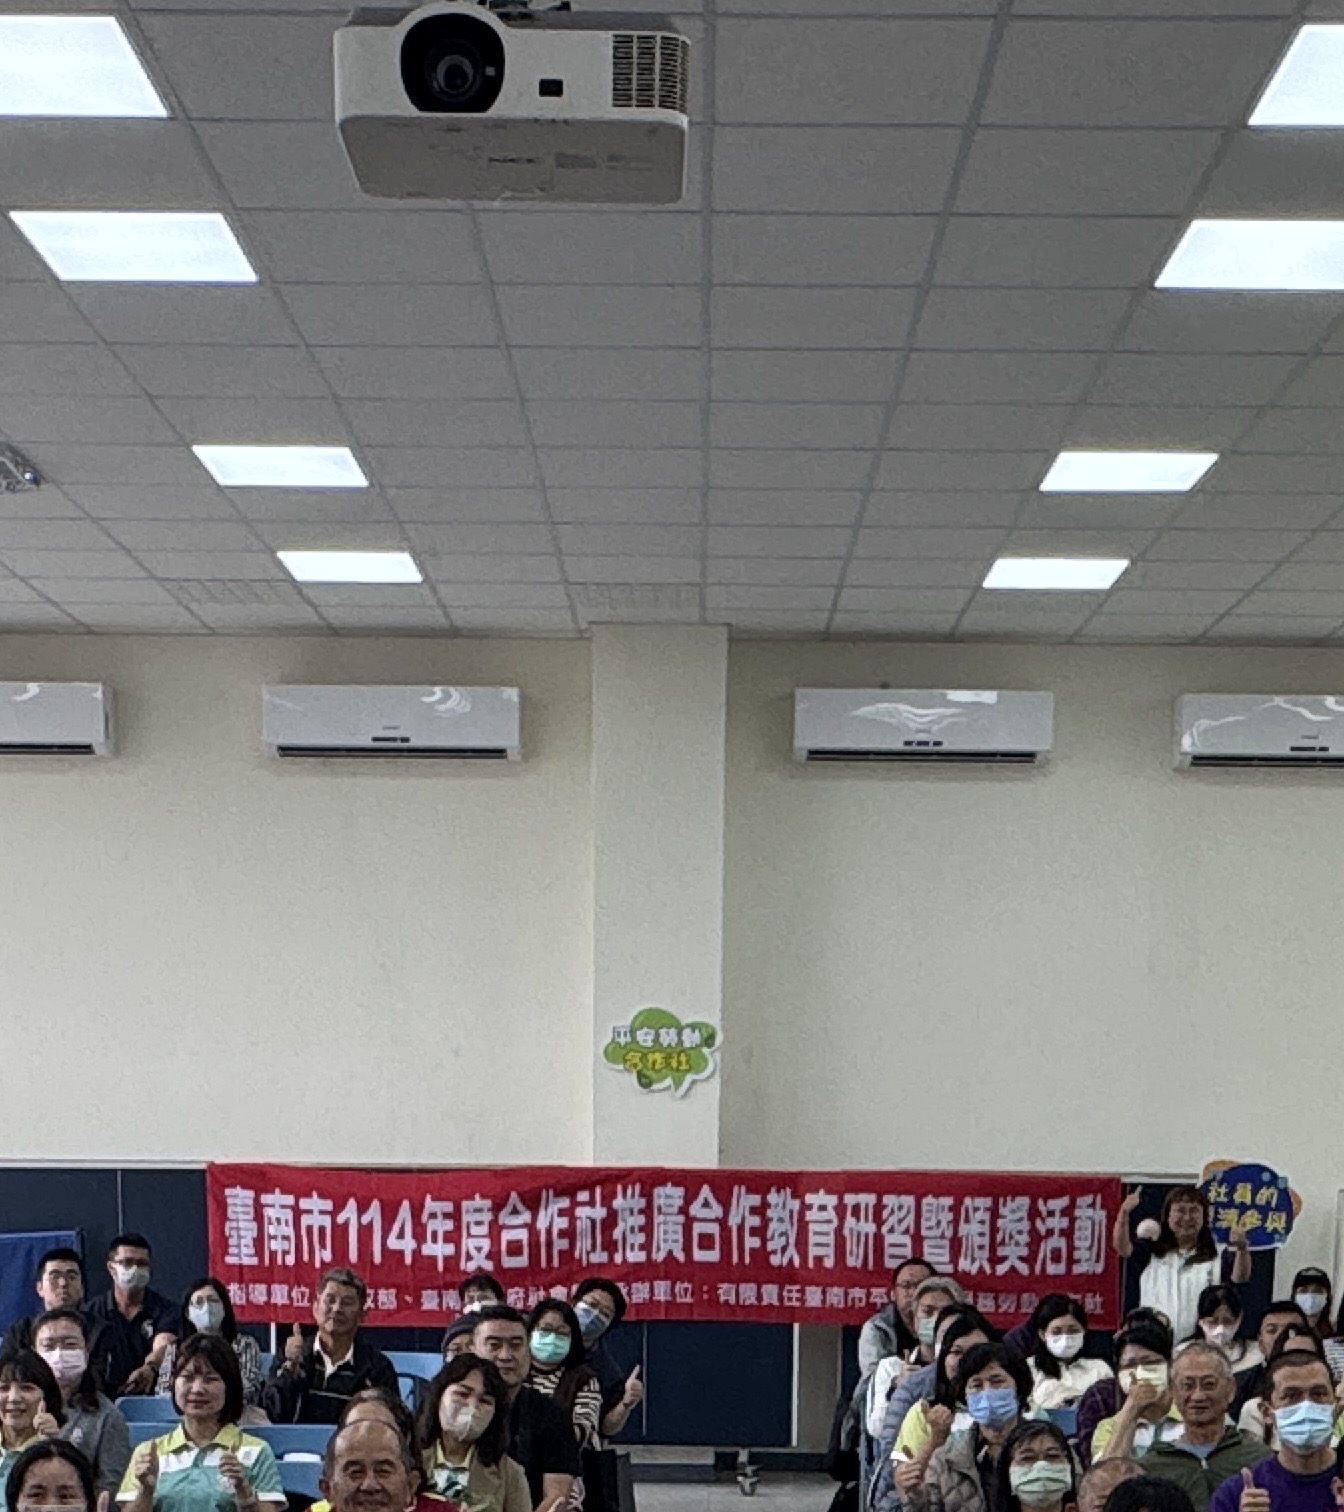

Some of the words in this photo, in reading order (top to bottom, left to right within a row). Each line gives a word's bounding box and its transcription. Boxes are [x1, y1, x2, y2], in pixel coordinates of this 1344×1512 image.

[224, 1181, 1107, 1276] 臺南市114年度合作社推廣合作教育研習暨頒獎活動
